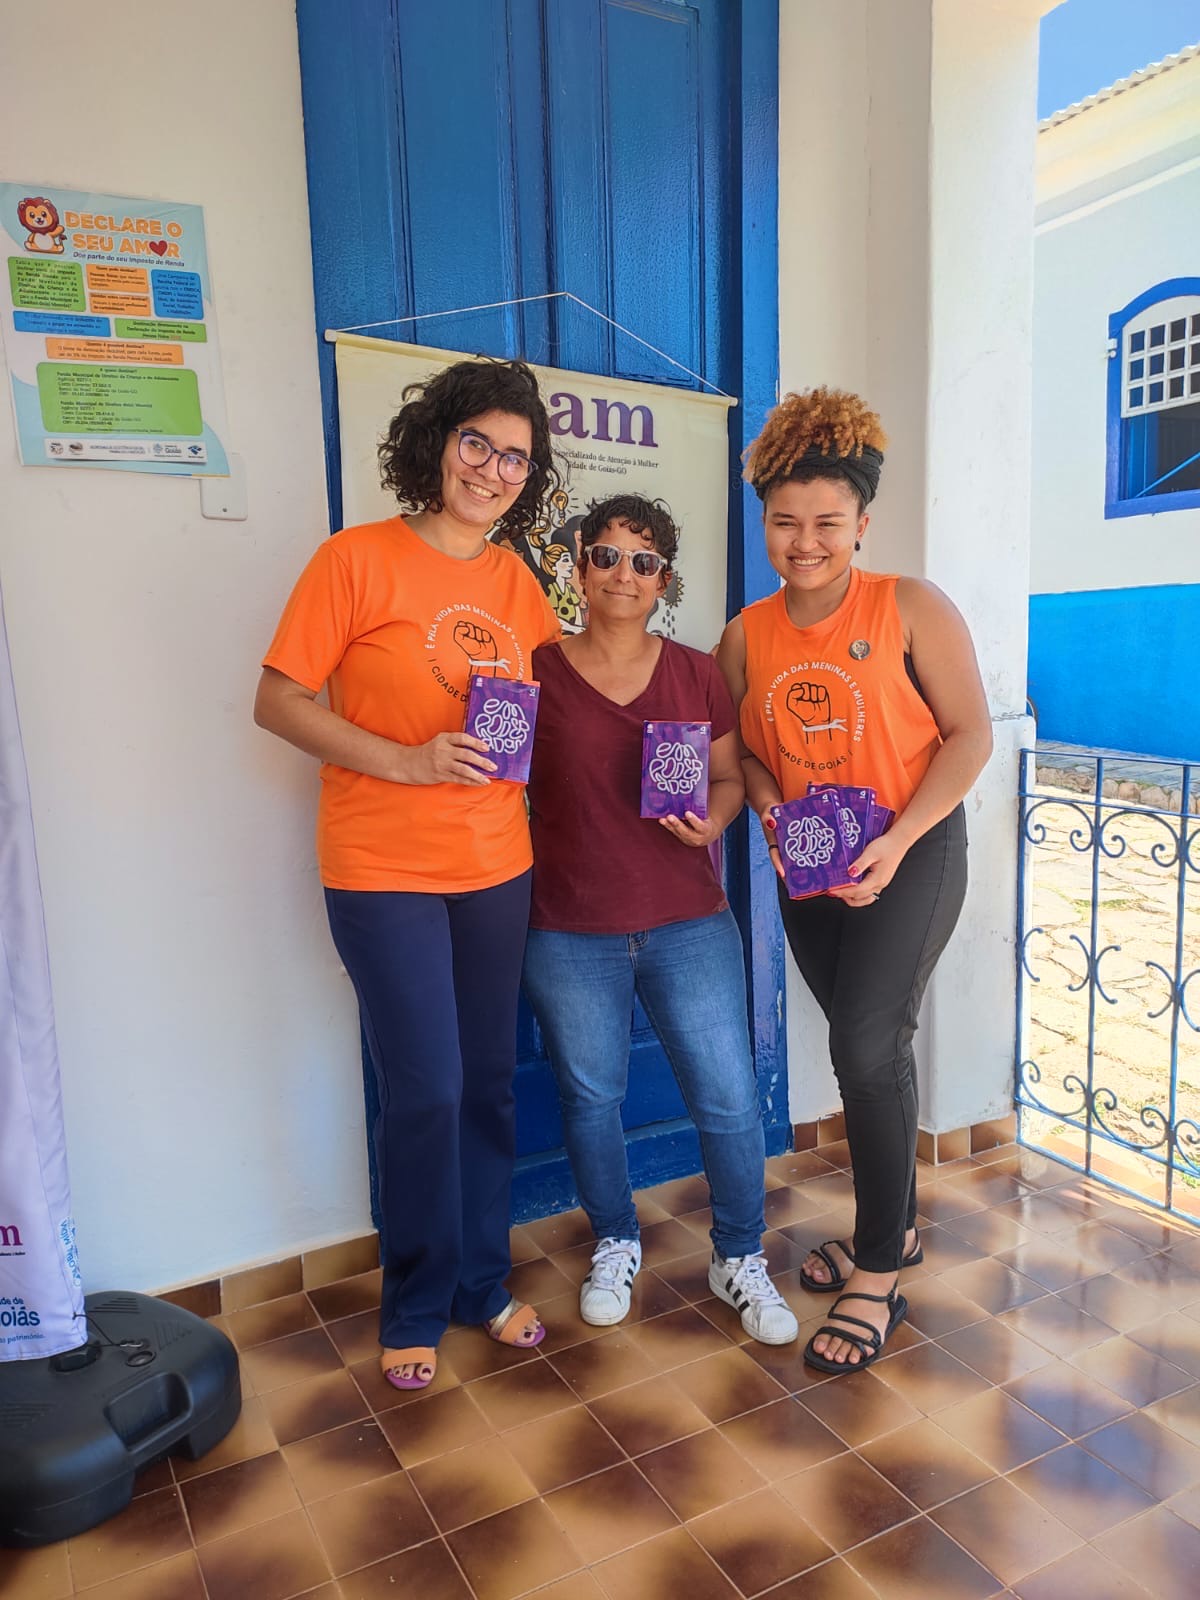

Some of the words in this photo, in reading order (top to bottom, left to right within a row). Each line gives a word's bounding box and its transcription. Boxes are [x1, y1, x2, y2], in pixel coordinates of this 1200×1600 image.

[65, 211, 162, 236] DECLARE
[167, 222, 182, 238] O
[72, 233, 114, 252] SEU
[589, 463, 596, 471] de
[607, 456, 631, 465] Atenção
[638, 459, 658, 468] Mulher
[427, 623, 439, 642] PELA
[434, 607, 455, 622] VIDA
[453, 603, 471, 611] DAS
[472, 606, 512, 633] MENINAS
[432, 666, 460, 698] CIDADE
[765, 692, 774, 714] PELA
[770, 671, 790, 689] VIDA
[790, 662, 809, 674] DAS
[811, 662, 852, 684] MENINAS
[852, 690, 865, 742] MULHERES
[778, 744, 802, 765] IDADE
[804, 760, 816, 770] DE
[0, 1306, 40, 1327] oiás
